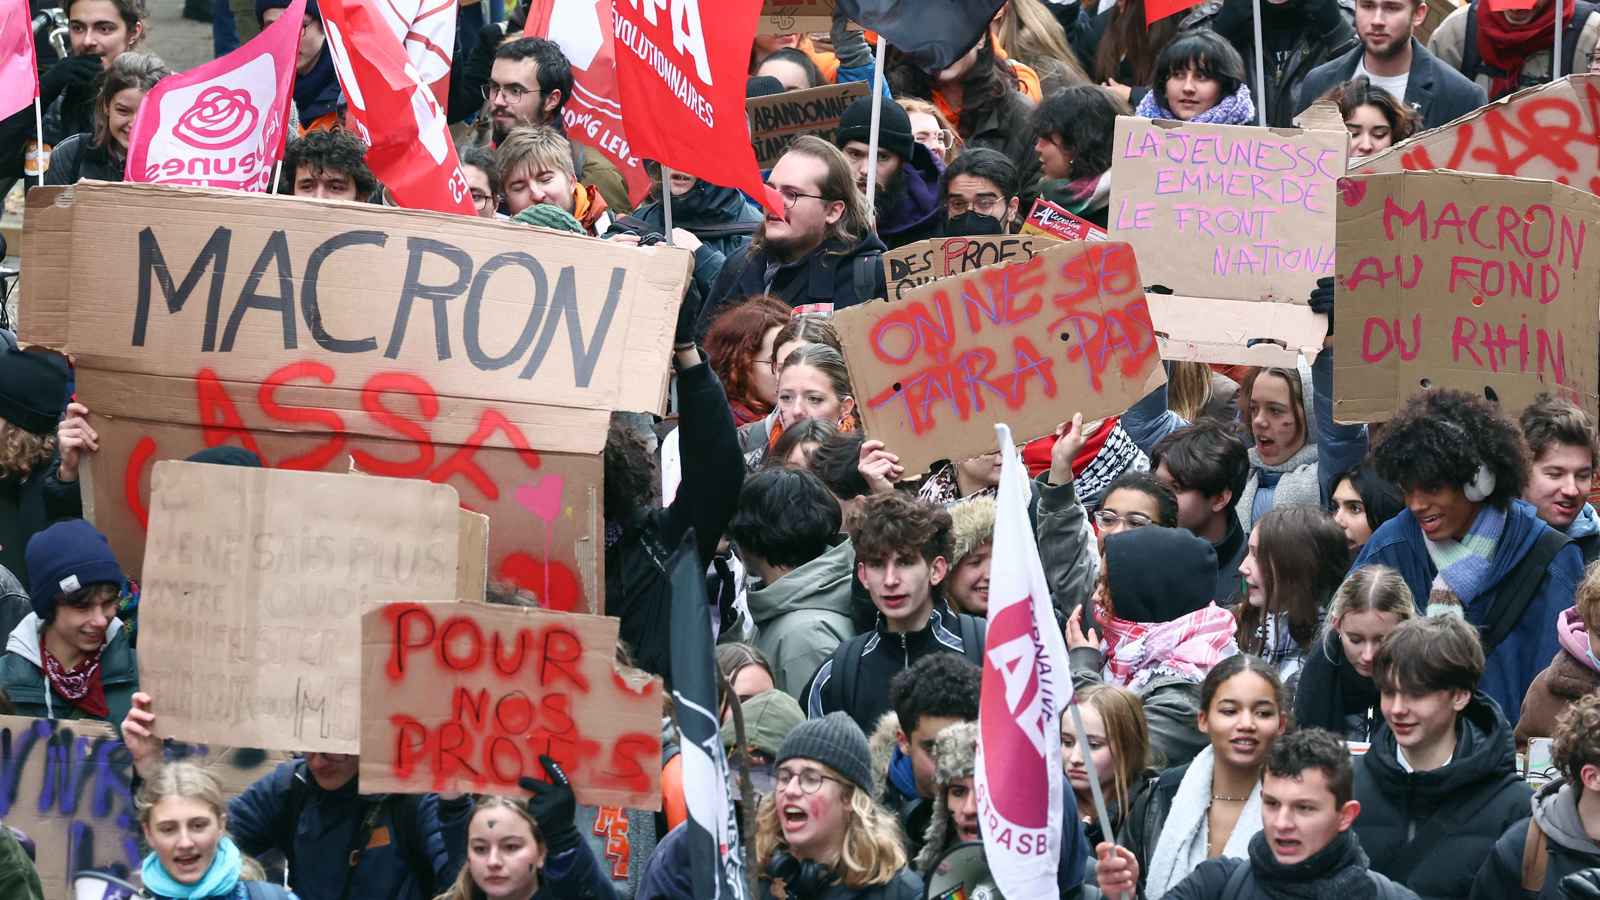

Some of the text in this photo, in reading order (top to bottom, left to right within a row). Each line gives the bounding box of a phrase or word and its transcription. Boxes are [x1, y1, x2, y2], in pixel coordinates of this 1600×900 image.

[1124, 129, 1339, 180] LA JEUNESSE
[1116, 195, 1277, 240] LE FRONT
[1382, 196, 1586, 271] MACRON
[890, 237, 1033, 281] DES PROFS
[1346, 255, 1561, 305] AU FOND
[132, 225, 626, 388] MACRON
[869, 288, 956, 365] ON
[959, 255, 1047, 335] NE
[1052, 242, 1139, 309] SE
[1047, 299, 1157, 394] PAS
[1361, 313, 1424, 364] DU
[348, 536, 450, 585] PLUS
[385, 603, 590, 693] POUR
[452, 687, 577, 736] NOS
